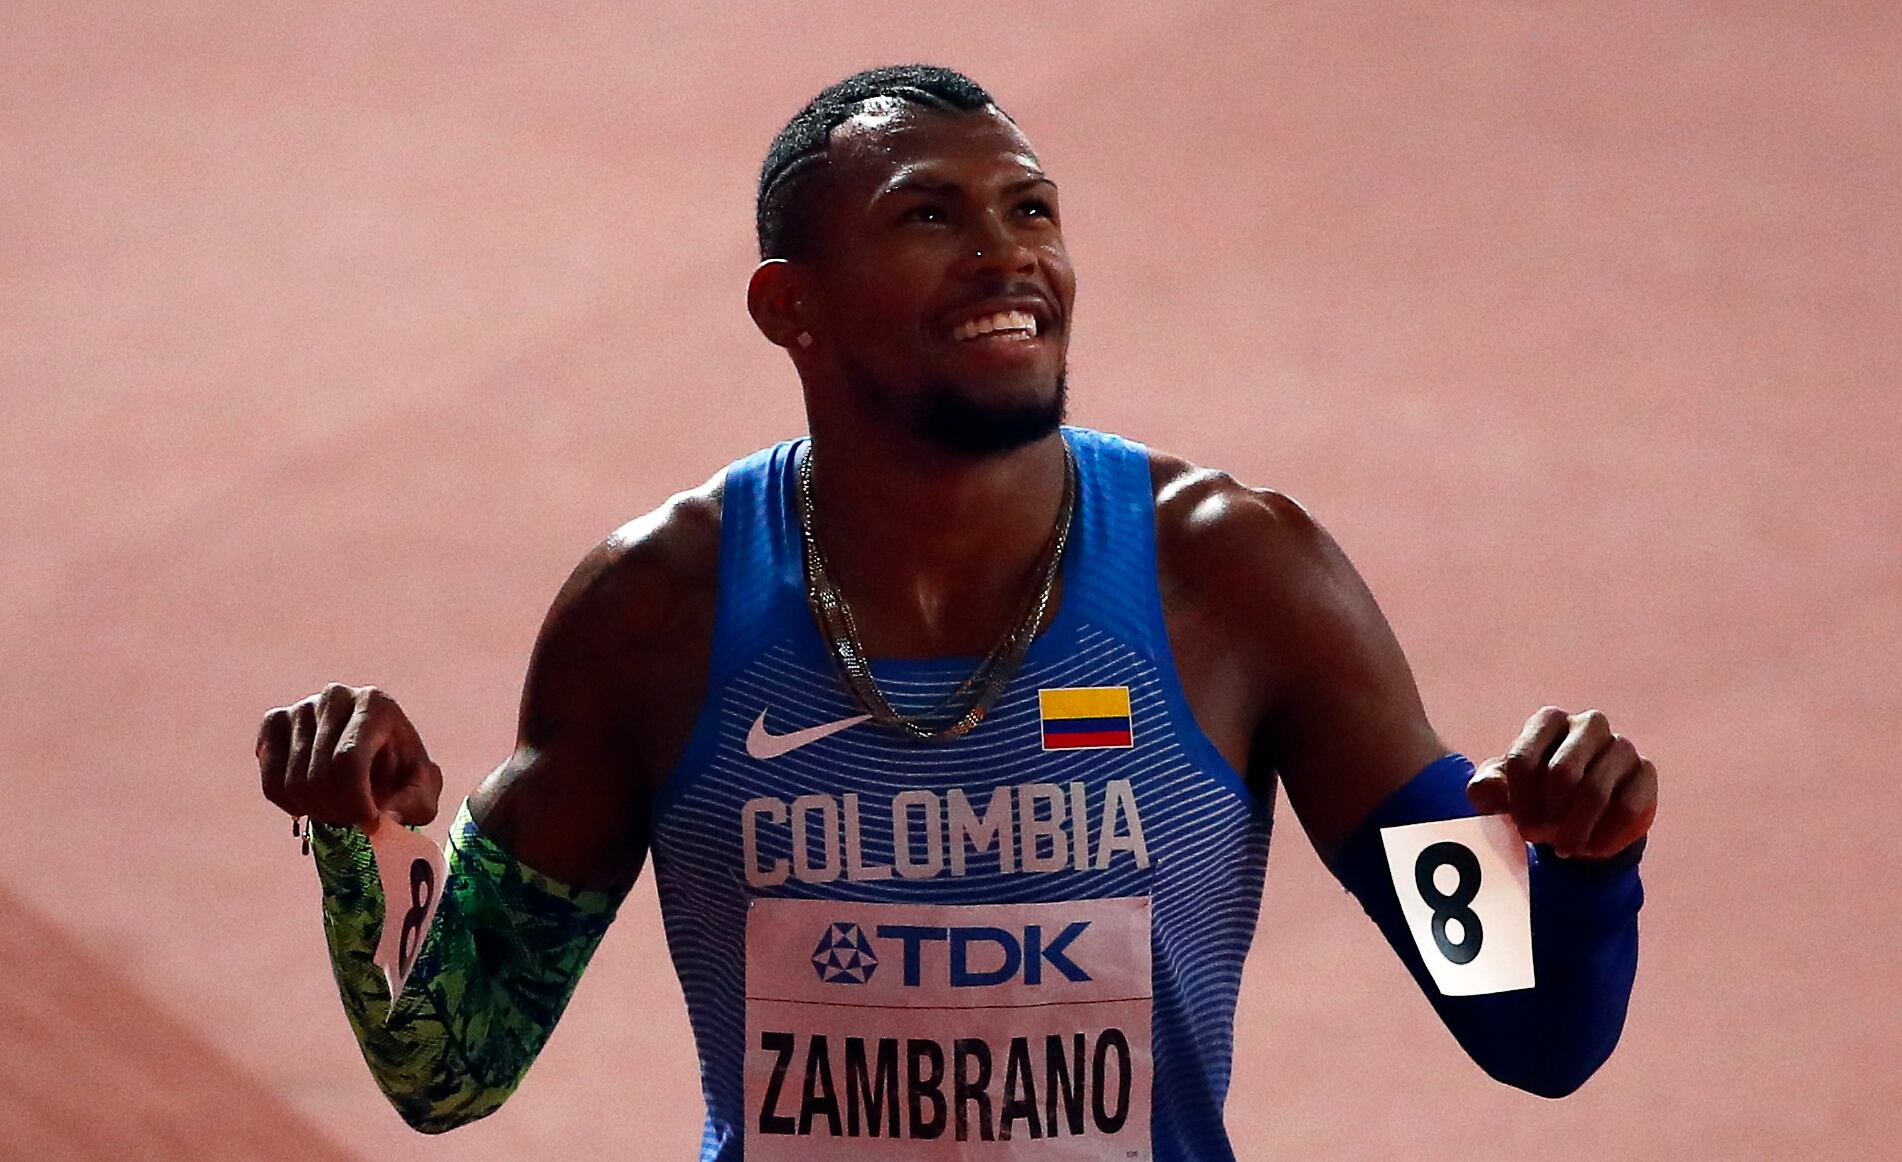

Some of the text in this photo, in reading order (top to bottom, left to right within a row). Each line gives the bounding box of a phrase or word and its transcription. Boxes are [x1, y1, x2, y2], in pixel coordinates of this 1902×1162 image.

[741, 779, 1150, 887] COLOMBIA
[398, 858, 435, 979] 8
[877, 921, 1093, 987] TDK
[1415, 841, 1484, 966] 8
[759, 1028, 1132, 1142] ZAMBRANO
